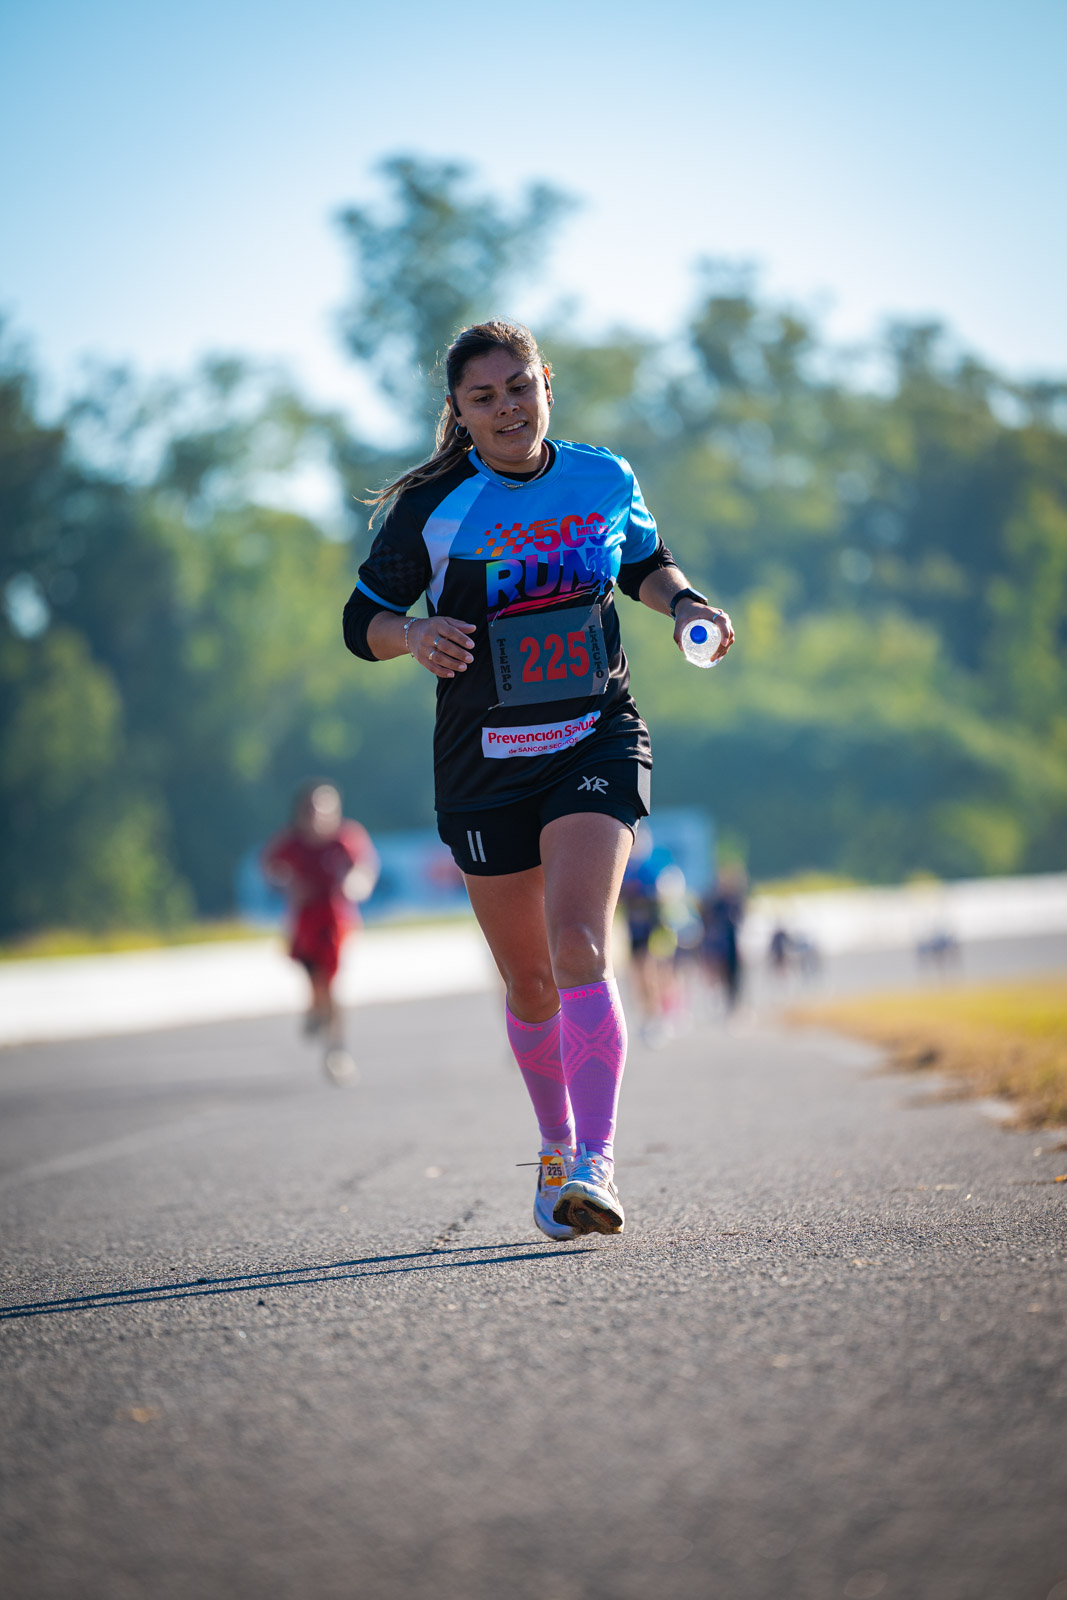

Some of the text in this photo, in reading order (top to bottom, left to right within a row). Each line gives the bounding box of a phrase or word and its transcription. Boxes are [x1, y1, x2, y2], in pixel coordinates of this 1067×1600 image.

[486, 548, 610, 607] RUN
[496, 638, 512, 691] TIEMPO
[519, 631, 590, 683] 225
[588, 624, 604, 679] EXACTO
[488, 729, 562, 744] Prevención
[518, 745, 548, 753] SANCOR
[577, 775, 610, 795] XR
[547, 1166, 563, 1176] 225
